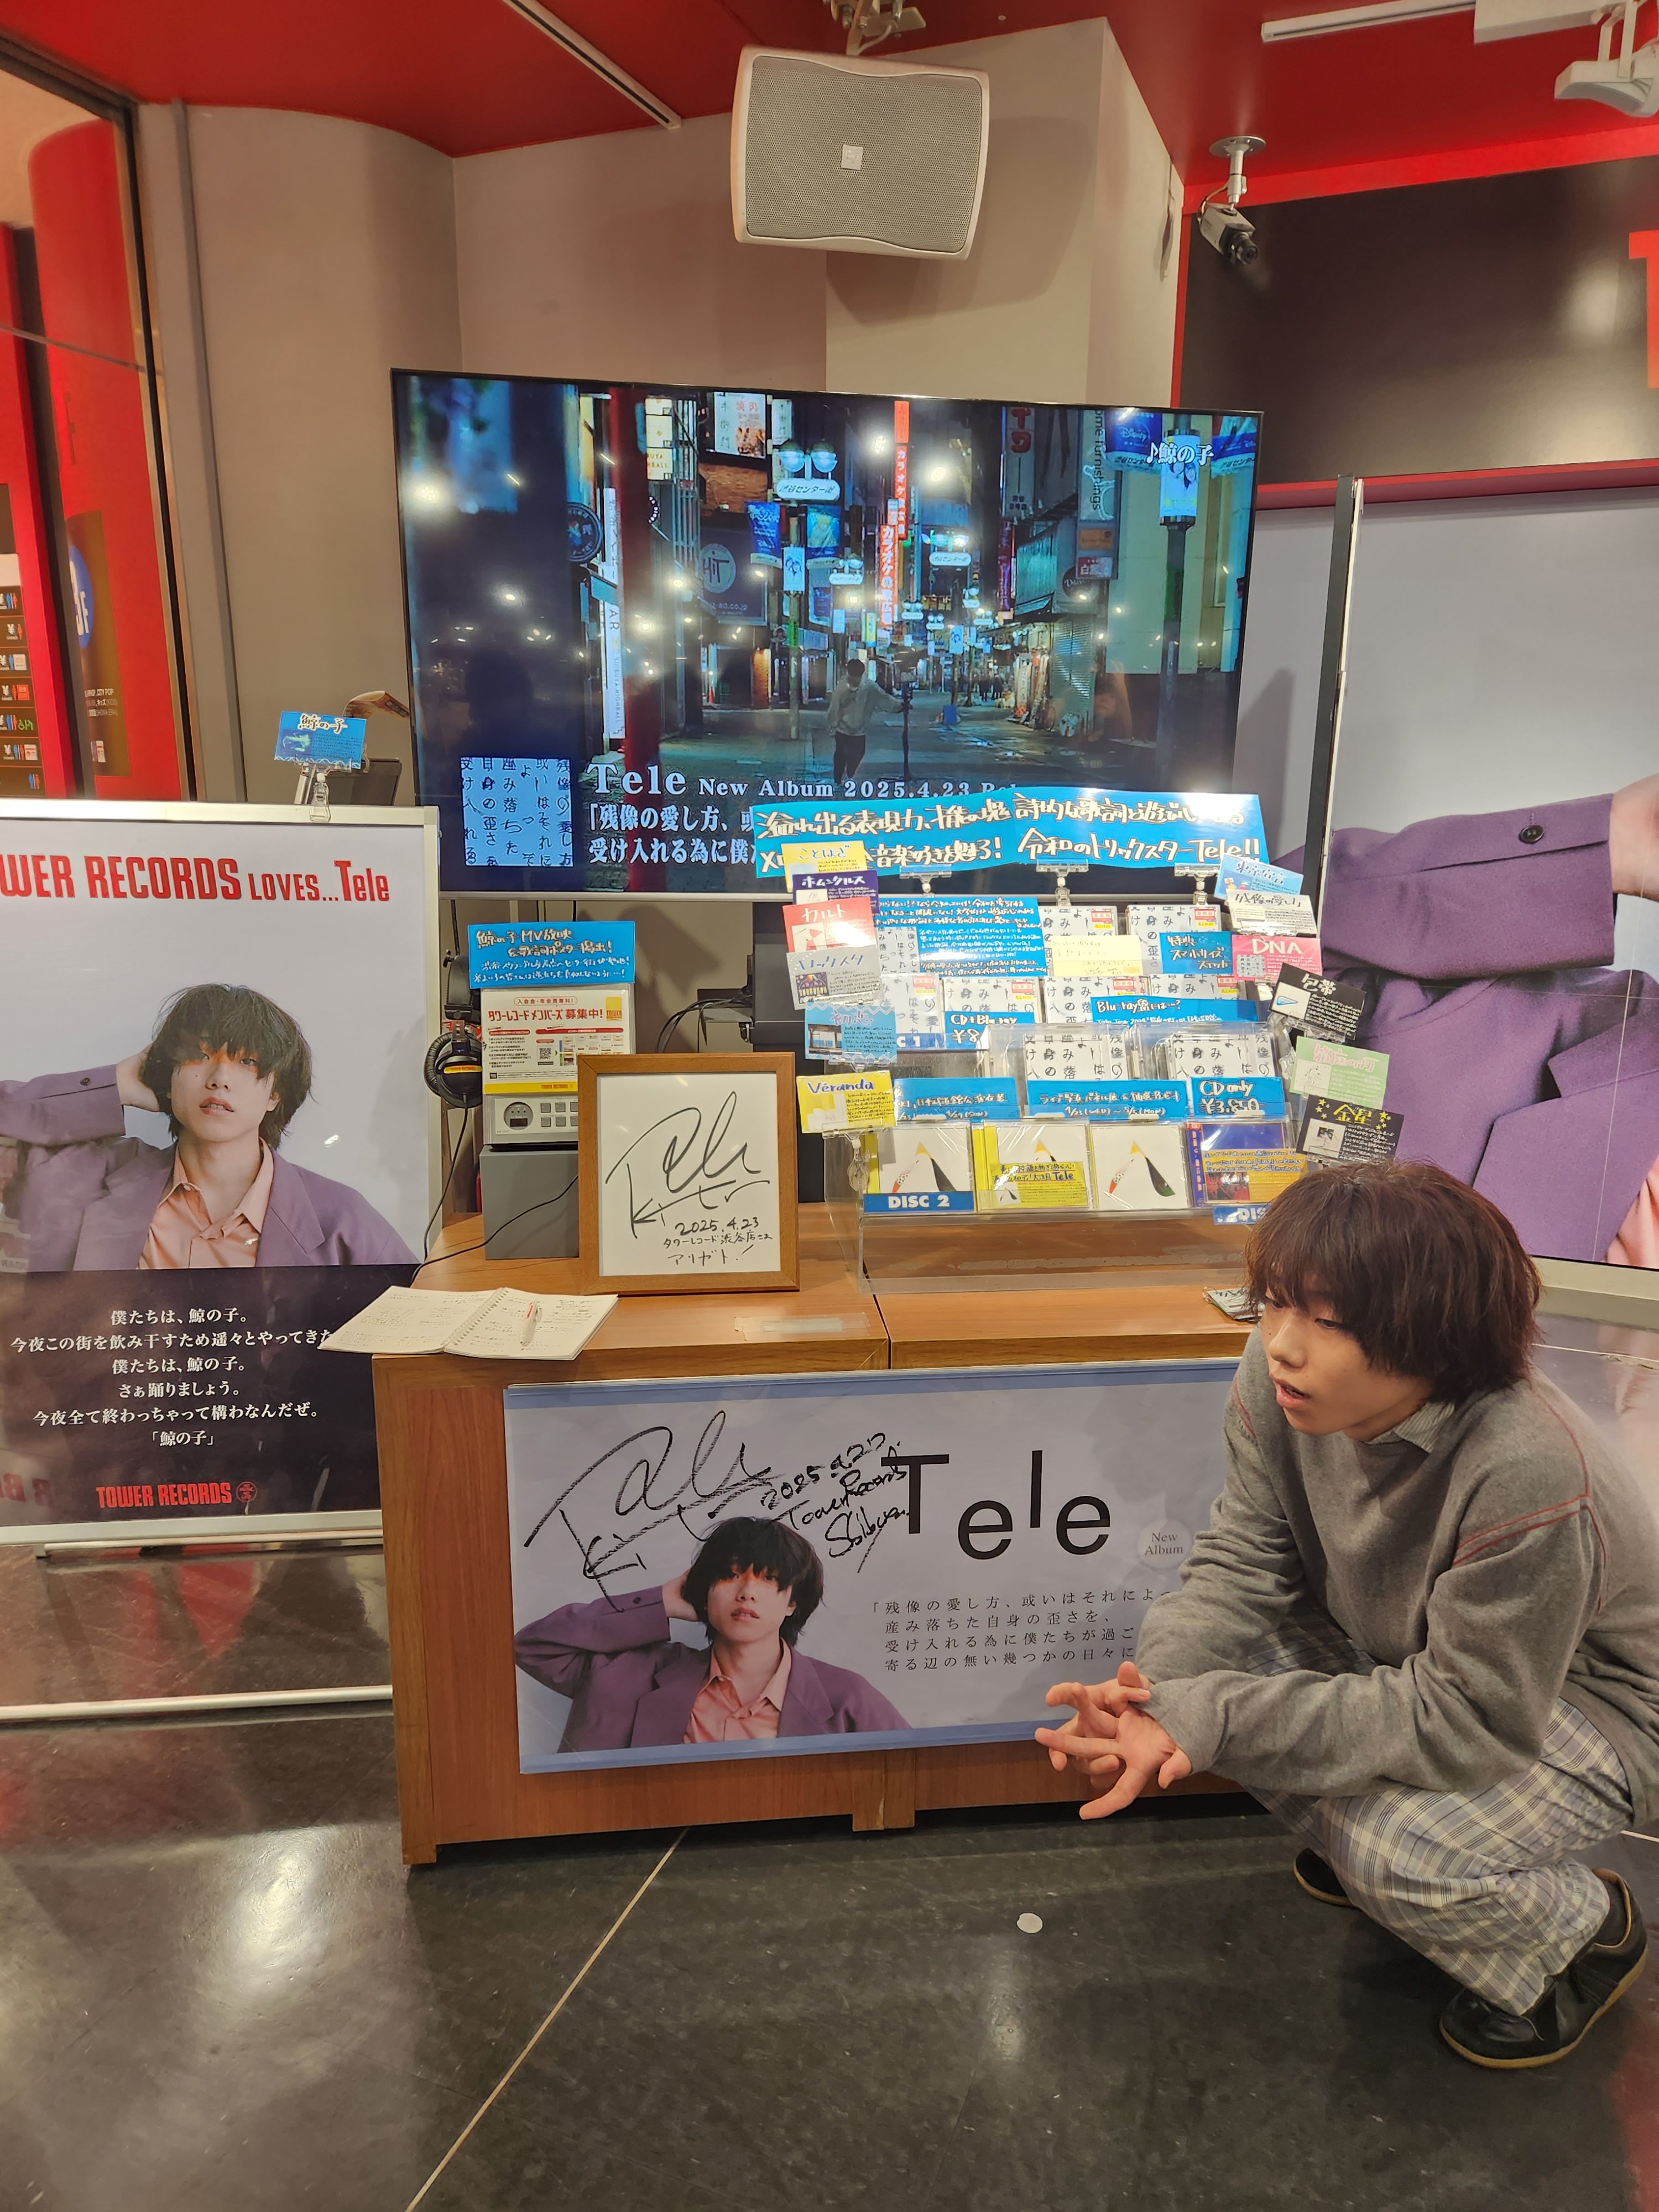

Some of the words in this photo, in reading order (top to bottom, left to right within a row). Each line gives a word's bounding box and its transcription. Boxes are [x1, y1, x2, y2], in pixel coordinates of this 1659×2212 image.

[1158, 442, 1214, 466] 鯨の子
[298, 713, 348, 734] 鯨の子
[587, 763, 687, 795] Tele
[698, 778, 749, 796] New
[759, 779, 833, 797] Album
[844, 779, 969, 797] 2025.4.23
[589, 838, 755, 865] 受け入れる為に僕
[84, 855, 242, 900] RECORDS
[801, 875, 865, 888] ホムンクルス
[801, 904, 847, 922] カルト
[1251, 938, 1303, 954] DNA
[807, 1078, 874, 1094] Véranda
[1199, 1080, 1225, 1096] CD
[1225, 1079, 1254, 1097] only
[1333, 1104, 1372, 1125] 金星
[1053, 1170, 1074, 1180] Tele
[888, 1196, 929, 1208] DISC
[937, 1195, 951, 1207] 2
[675, 1217, 759, 1236] 2025.4.23
[110, 1307, 248, 1326] 僕たちは、鯨の子。
[112, 1355, 246, 1375] 僕たちは、鯨の子。
[118, 1381, 240, 1399] さぁ踊りましょう。
[32, 1401, 318, 1427] 今夜全て終わっちゃって構わなんだぜ。
[152, 1430, 215, 1447] 「鯨の子」
[96, 1485, 154, 1509] TOWER
[158, 1482, 232, 1506] RECORDS
[880, 1450, 1111, 1560] Tele
[1151, 1531, 1178, 1543] New
[1144, 1544, 1184, 1556] Album
[885, 1610, 1110, 1634] 産み落ちた自身の歪さを、
[885, 1627, 1135, 1653] 受け入れる為に僕たちが過ご
[885, 1646, 1135, 1672] 寄る辺の無い幾つかの日々に
